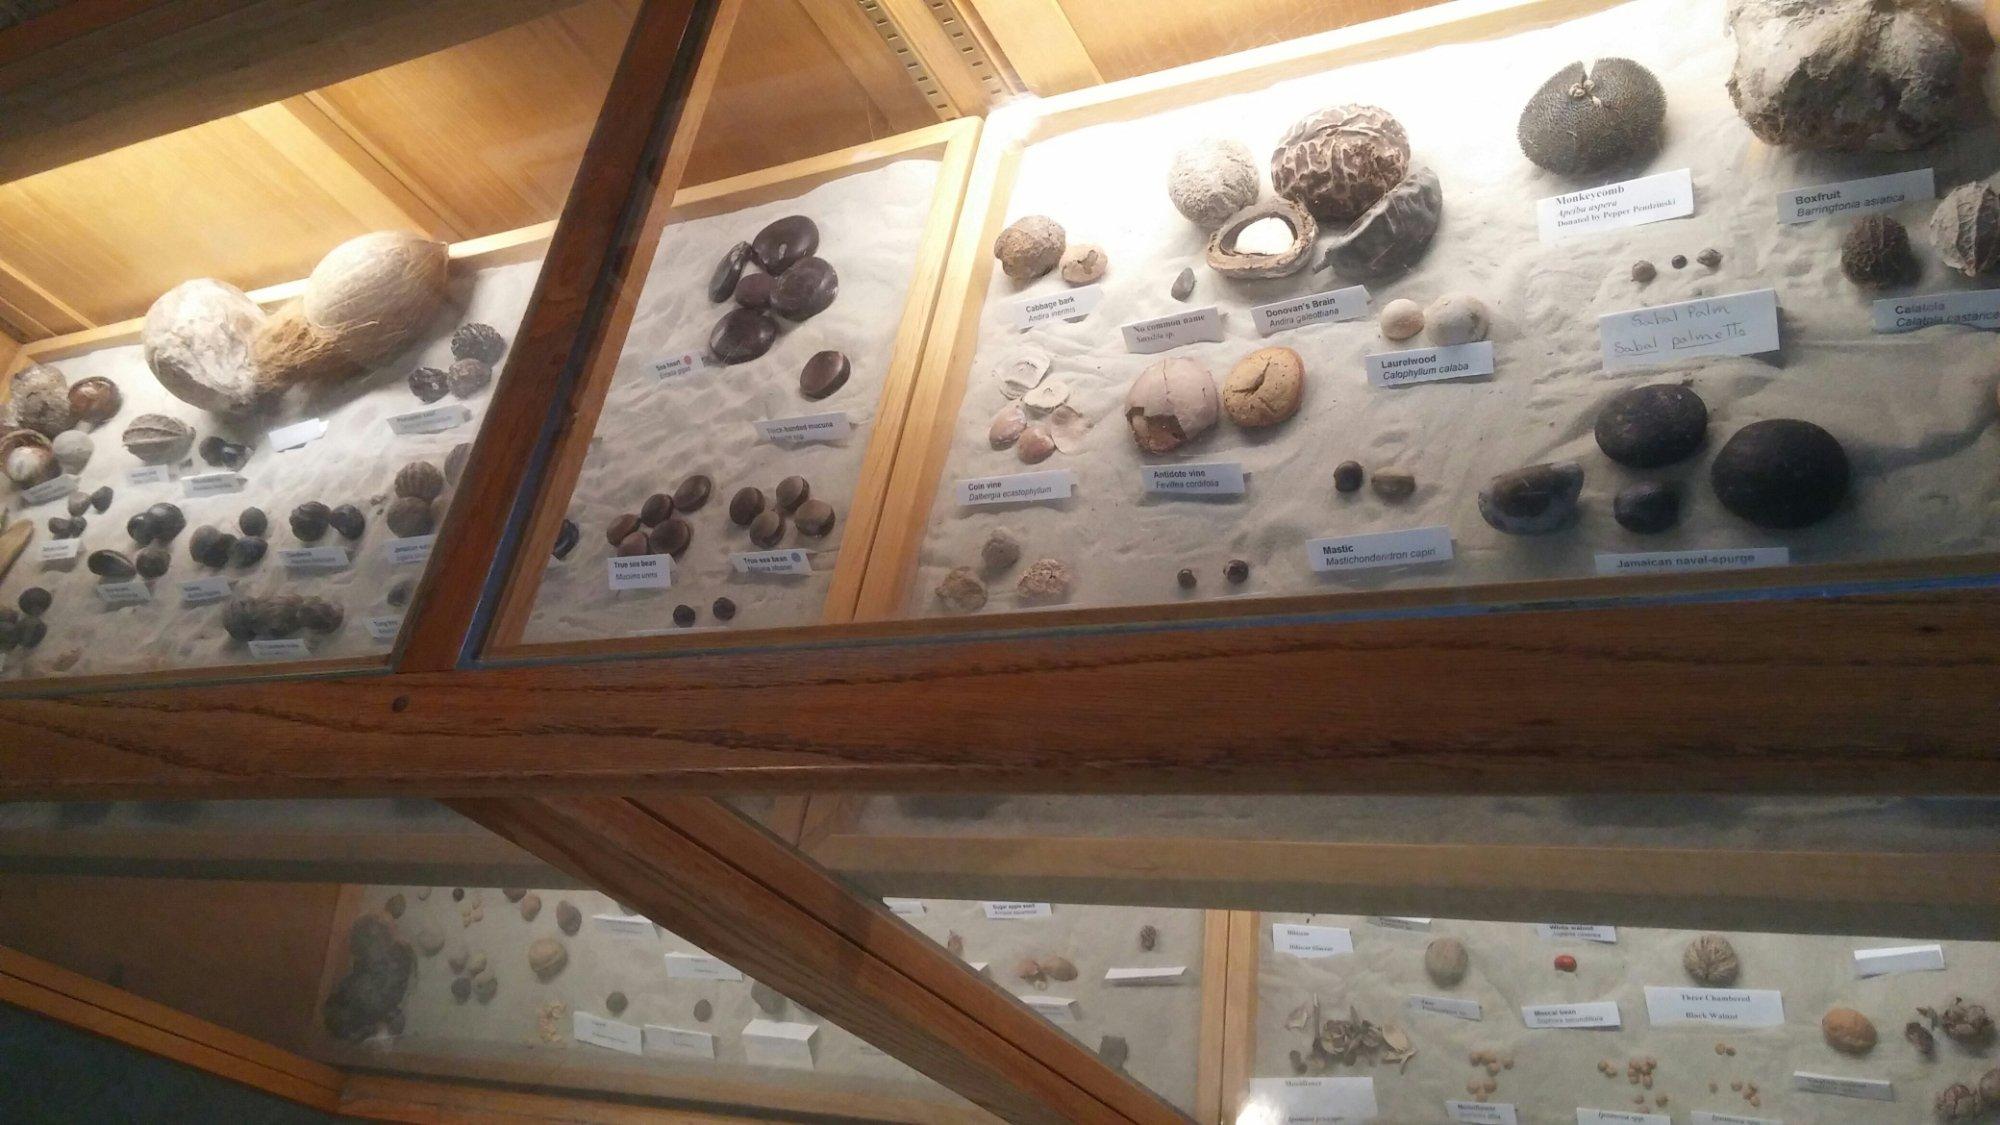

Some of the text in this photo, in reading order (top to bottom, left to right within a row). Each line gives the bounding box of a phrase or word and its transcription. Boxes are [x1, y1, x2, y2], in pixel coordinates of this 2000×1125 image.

[1555, 184, 1625, 205] Monkeycomb
[1795, 190, 1842, 205] Boxfruit
[1796, 193, 1905, 218] Barringtonia asiatica
[1557, 215, 1590, 227] Donated
[1591, 213, 1600, 222] by
[1603, 208, 1631, 220] Pepper
[1025, 296, 1075, 314] Cabbage bark
[1265, 297, 1336, 318] Donovan's Brain
[1028, 311, 1050, 323] Andira
[1269, 315, 1294, 328] Andira
[1631, 303, 1730, 327] Sabal Palm
[1132, 314, 1206, 334] No common name
[1614, 337, 1658, 354] Sabal
[1381, 354, 1437, 369] Laurelwood
[1382, 362, 1470, 381] Calophyllum calaba
[1153, 470, 1205, 479] Antidote vine
[968, 481, 1002, 491] Coin vine
[968, 490, 1001, 502] Dalbergia
[1322, 544, 1354, 555] Mastic
[614, 559, 657, 569] True sea bean
[1616, 554, 1755, 568] Jamaican naval-spurge
[1681, 993, 1751, 1002] Three Chambered
[1685, 1012, 1738, 1020] Black Walnut
